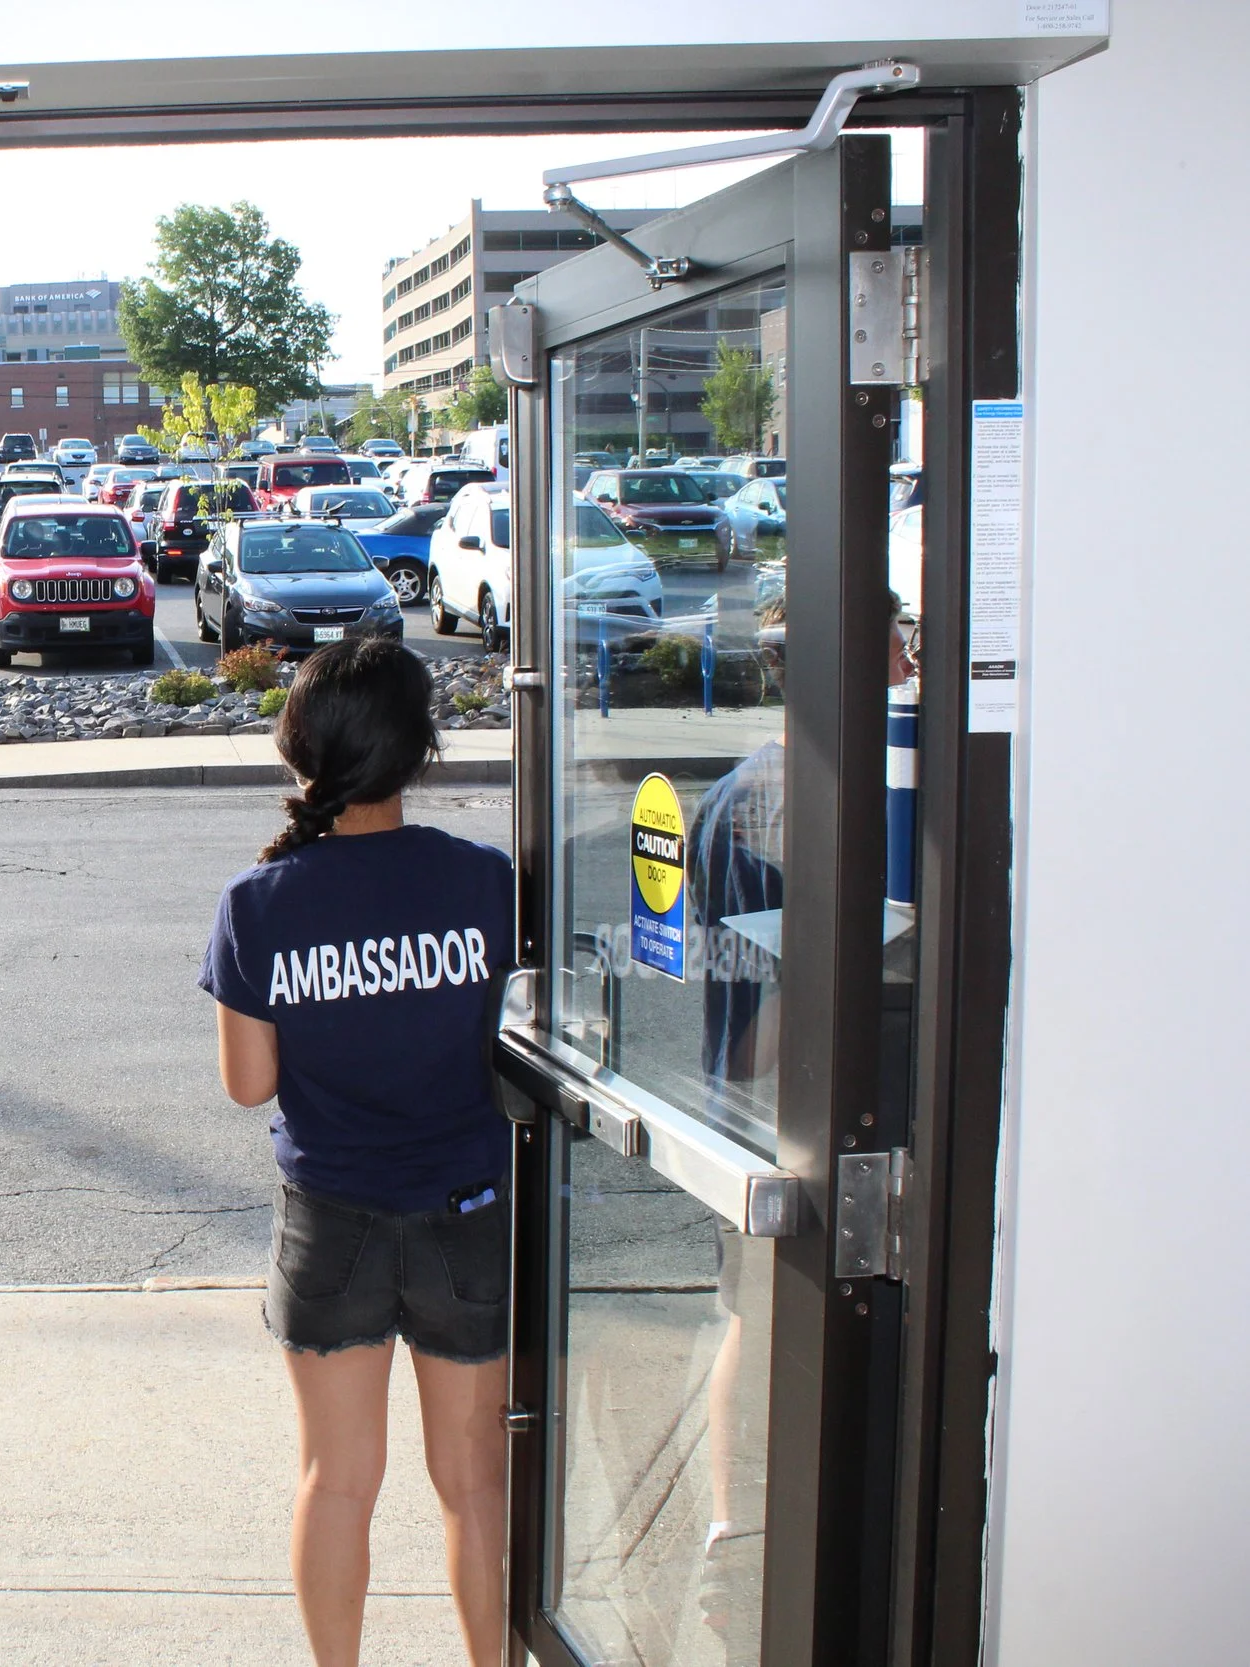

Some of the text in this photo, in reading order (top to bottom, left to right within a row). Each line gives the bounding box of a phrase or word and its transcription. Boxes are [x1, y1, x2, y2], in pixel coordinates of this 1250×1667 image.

[14, 295, 36, 303] BANK
[49, 292, 85, 301] AMERICA
[639, 808, 676, 830] AUTOMATIC
[636, 831, 679, 861] CAUTION
[647, 865, 667, 884] DOOR
[633, 914, 682, 944] ACTIVATE SWITCH
[640, 935, 674, 961] TO OPERATE
[268, 927, 490, 1006] AMBASSADOR
